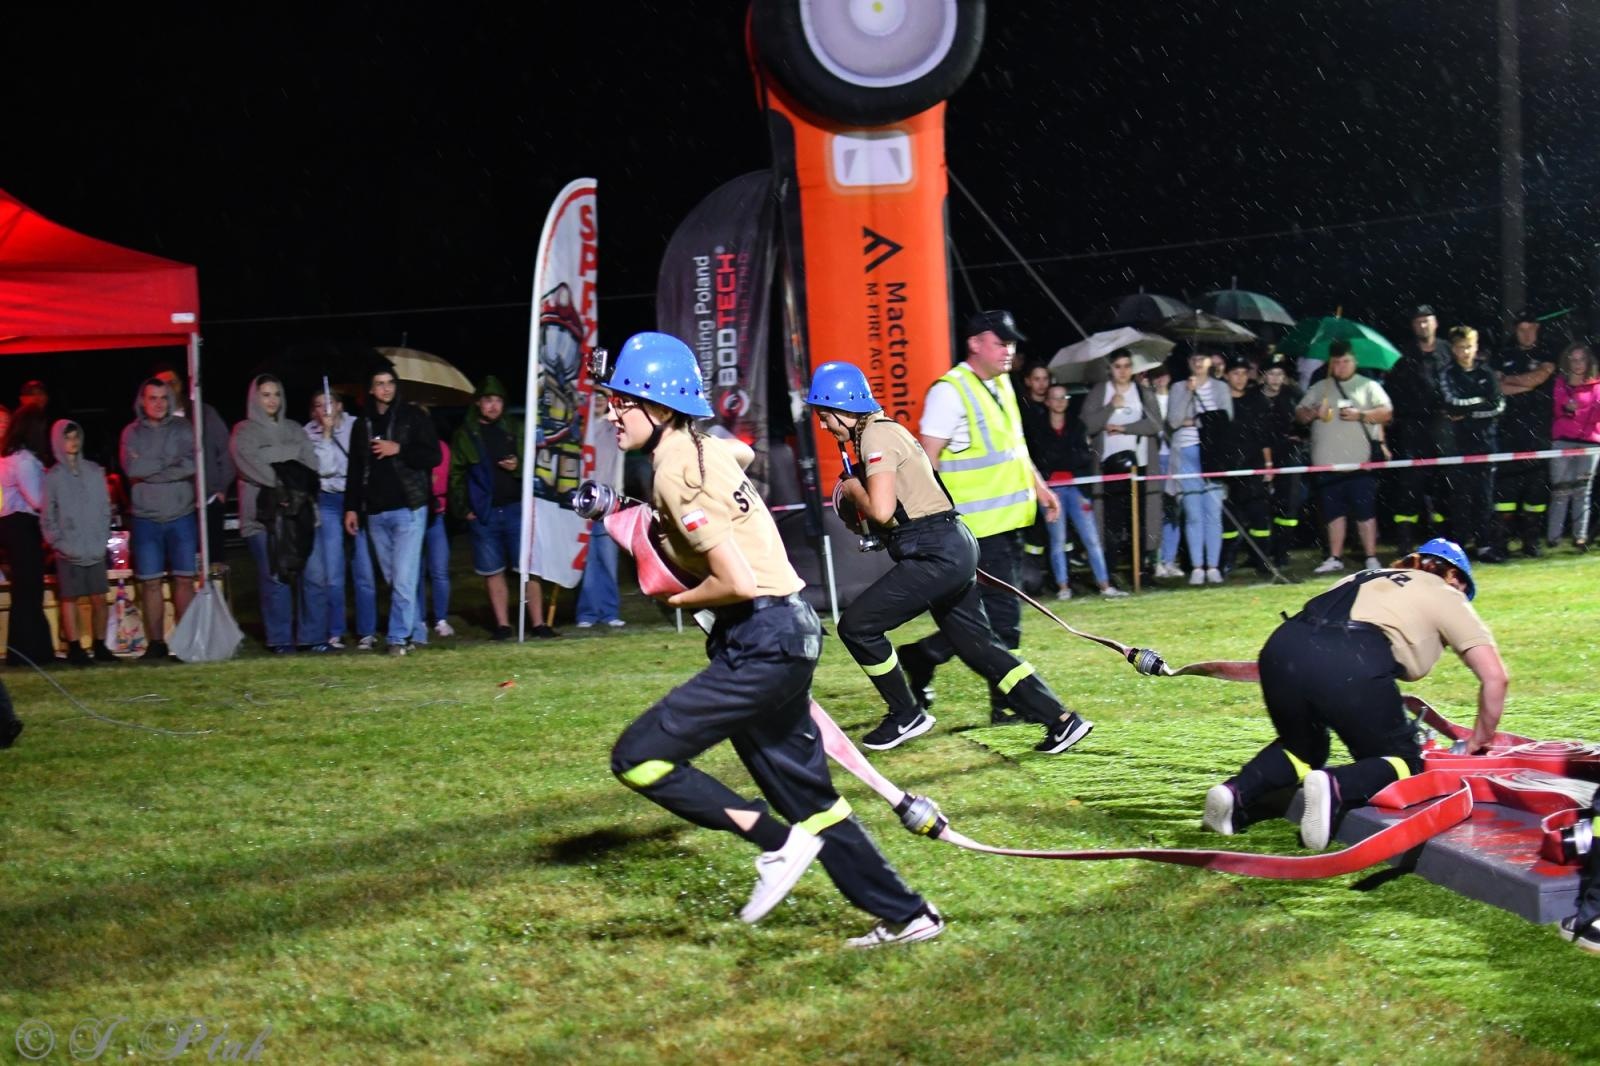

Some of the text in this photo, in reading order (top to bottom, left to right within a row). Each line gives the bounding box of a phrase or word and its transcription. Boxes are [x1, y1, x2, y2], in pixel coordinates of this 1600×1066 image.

[693, 255, 712, 315] Poland
[869, 347, 884, 371] AG
[885, 281, 916, 422] Mactronic
